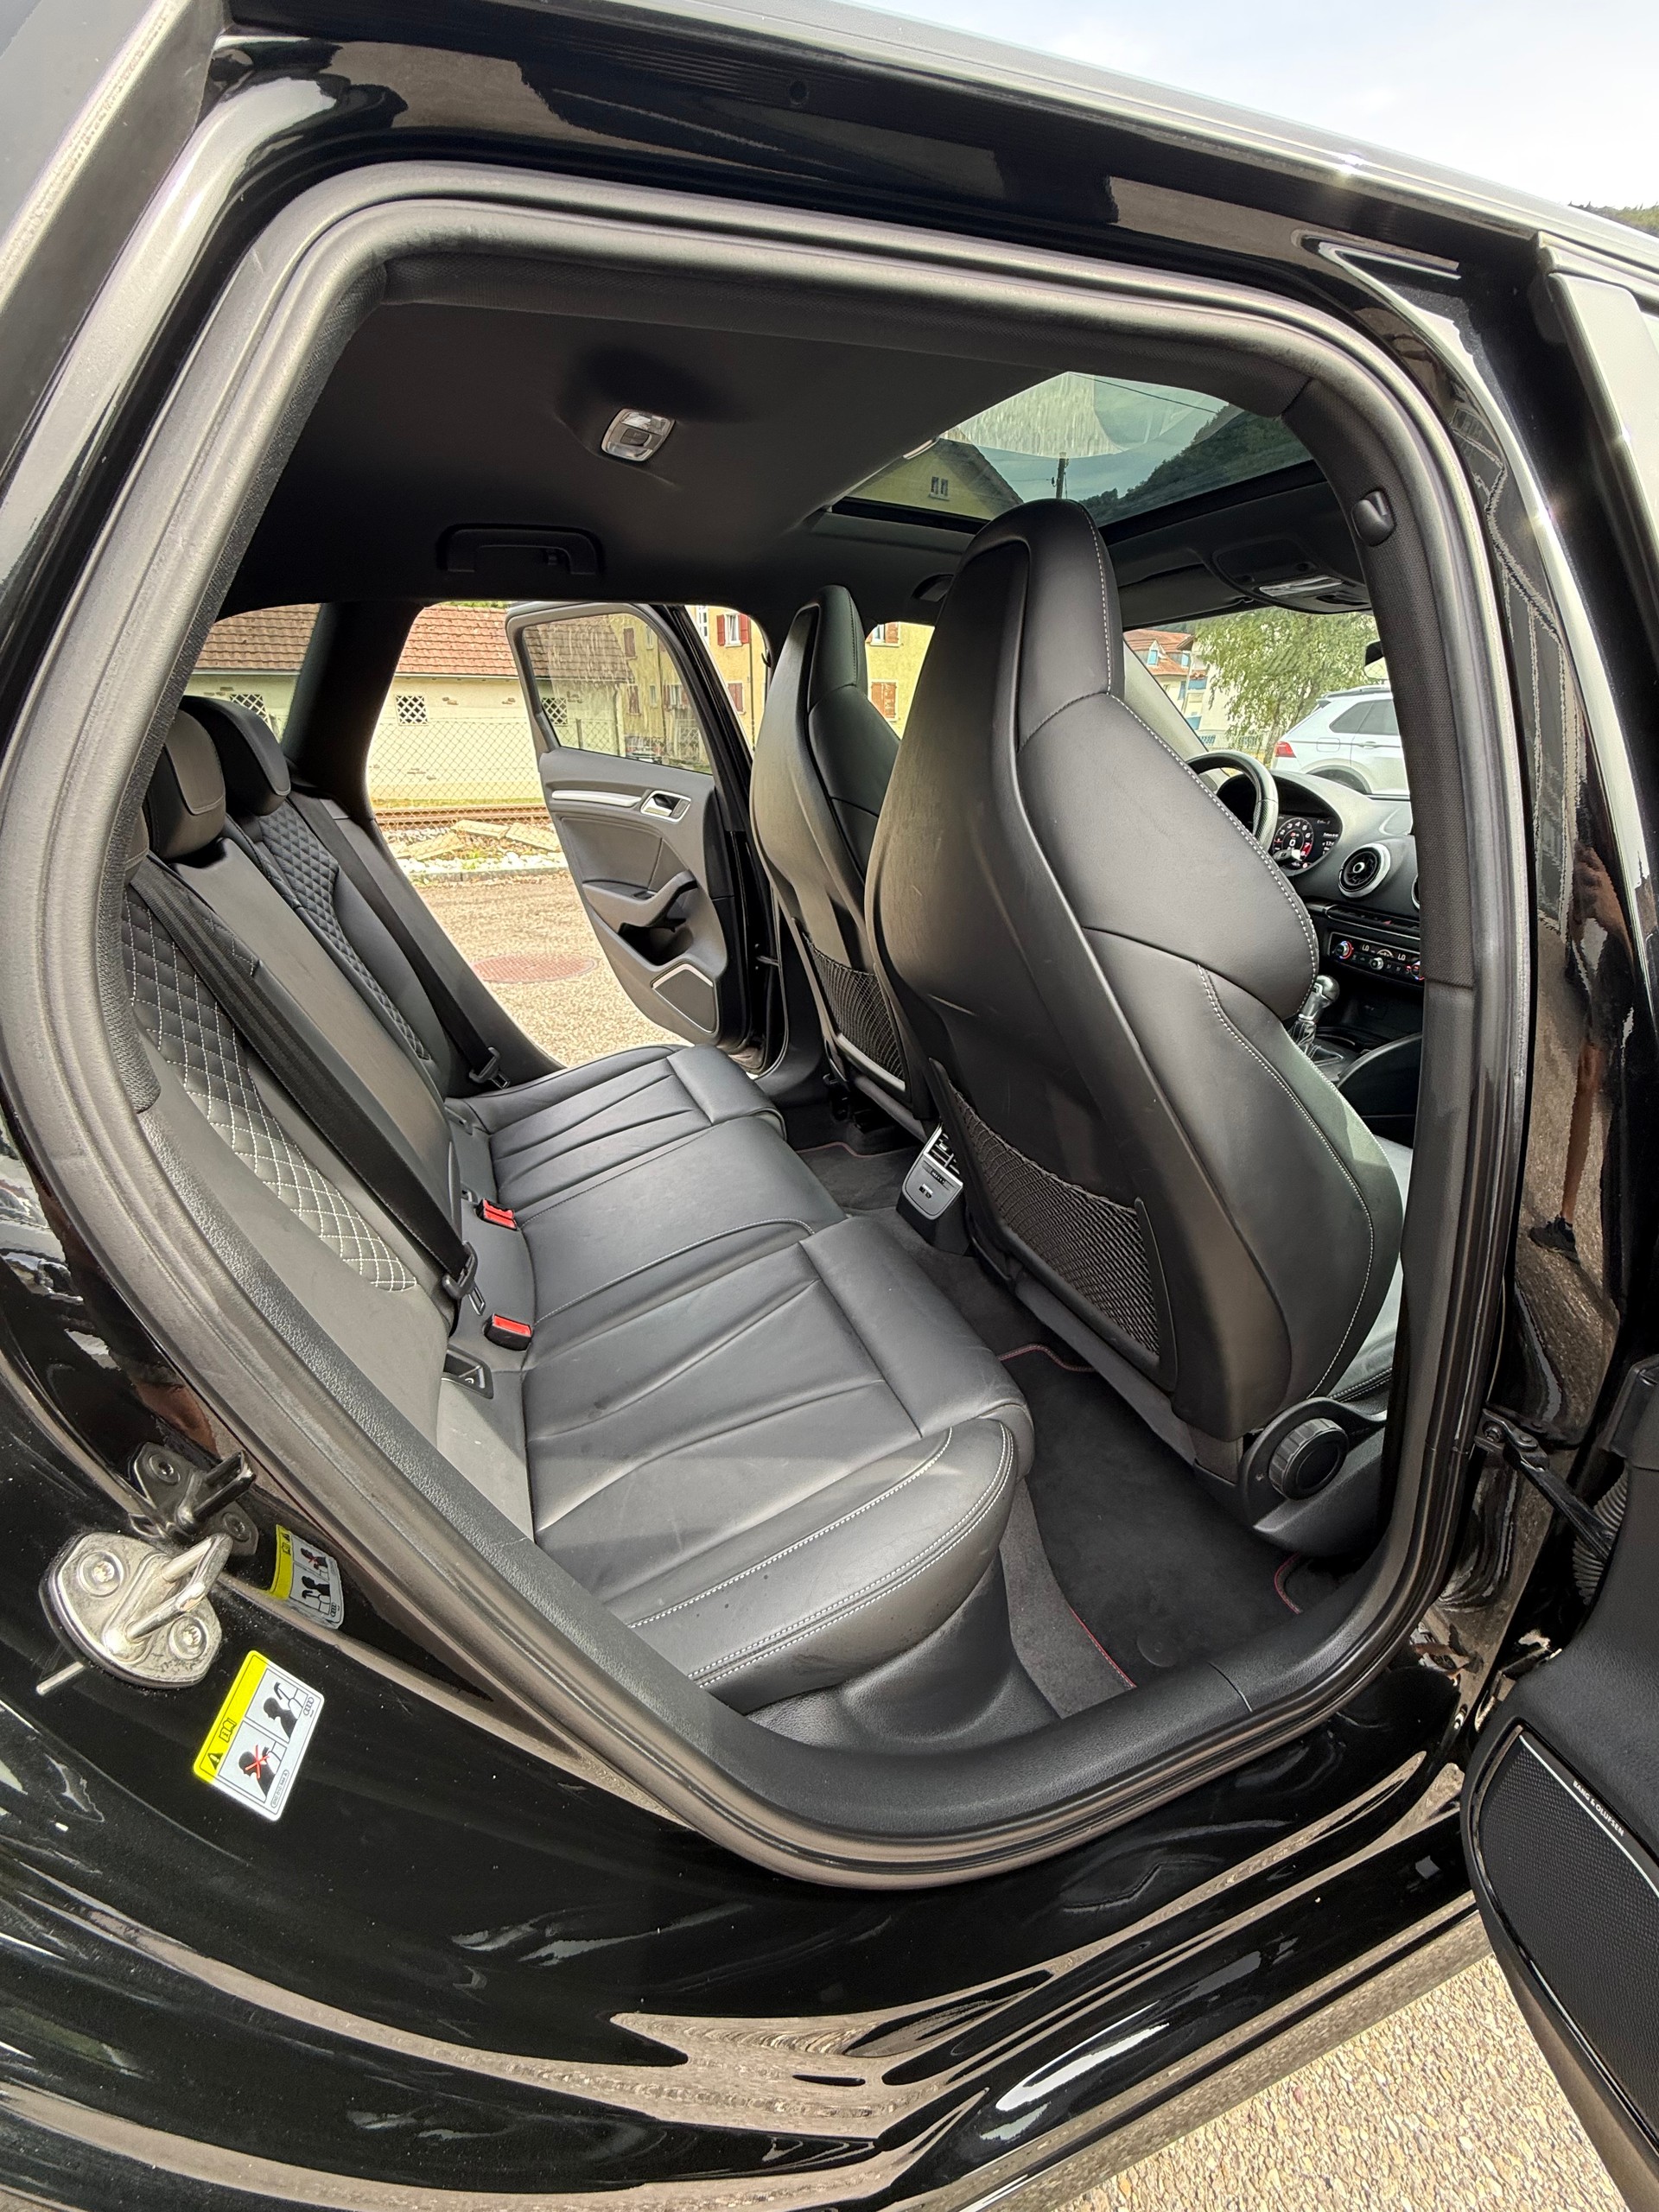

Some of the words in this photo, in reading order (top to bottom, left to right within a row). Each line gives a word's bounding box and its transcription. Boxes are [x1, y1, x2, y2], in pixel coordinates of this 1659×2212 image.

[1573, 1780, 1591, 1802] BANG
[1590, 1798, 1596, 1807] &
[1595, 1804, 1624, 1837] OLUFSEN
